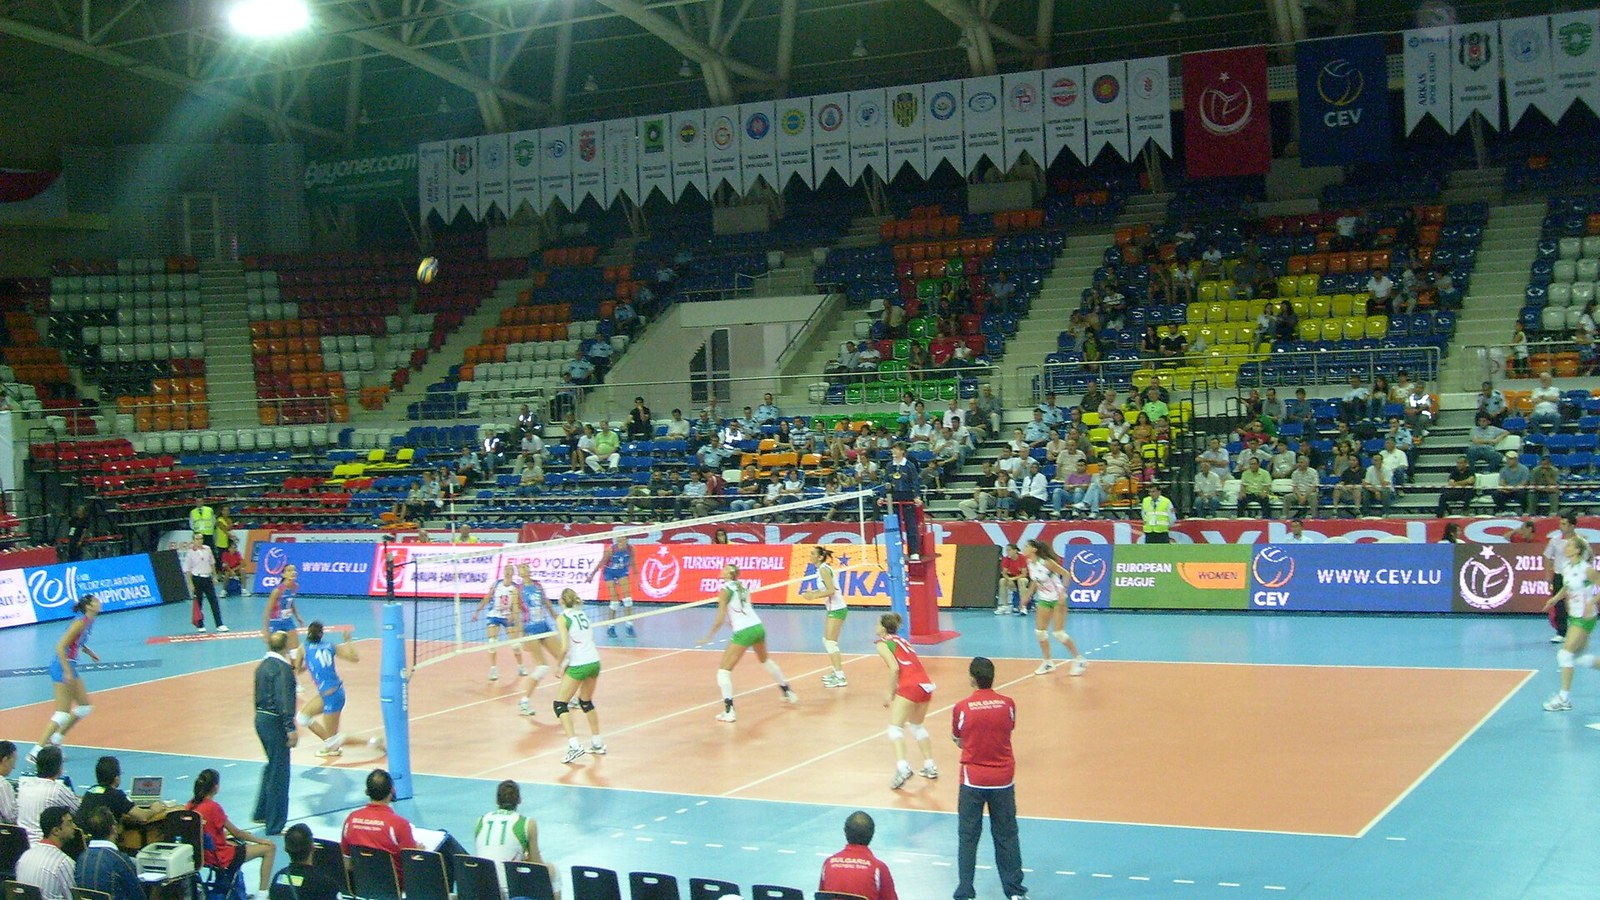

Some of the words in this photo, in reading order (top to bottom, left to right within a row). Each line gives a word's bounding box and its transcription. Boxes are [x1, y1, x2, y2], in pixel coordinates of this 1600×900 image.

[1324, 108, 1363, 127] CEV
[302, 561, 368, 573] WWW.CEV.LU
[545, 558, 595, 569] VOLLEY
[682, 556, 724, 570] TURKISH
[725, 556, 785, 570] VOLLEYBALL
[1116, 562, 1172, 573] EUROPEAN
[1514, 555, 1545, 571] 2011
[1115, 577, 1156, 587] LEAGUE
[1198, 571, 1238, 580] WOMEN
[1317, 568, 1442, 585] WWW.CEV.LU
[1070, 590, 1101, 603] CEV
[1254, 591, 1290, 607] CEV
[573, 613, 589, 631] 15
[314, 648, 333, 668] 10
[968, 699, 1006, 708] BULGARIA
[485, 820, 509, 846] 11
[830, 857, 871, 867] BULGARIA
